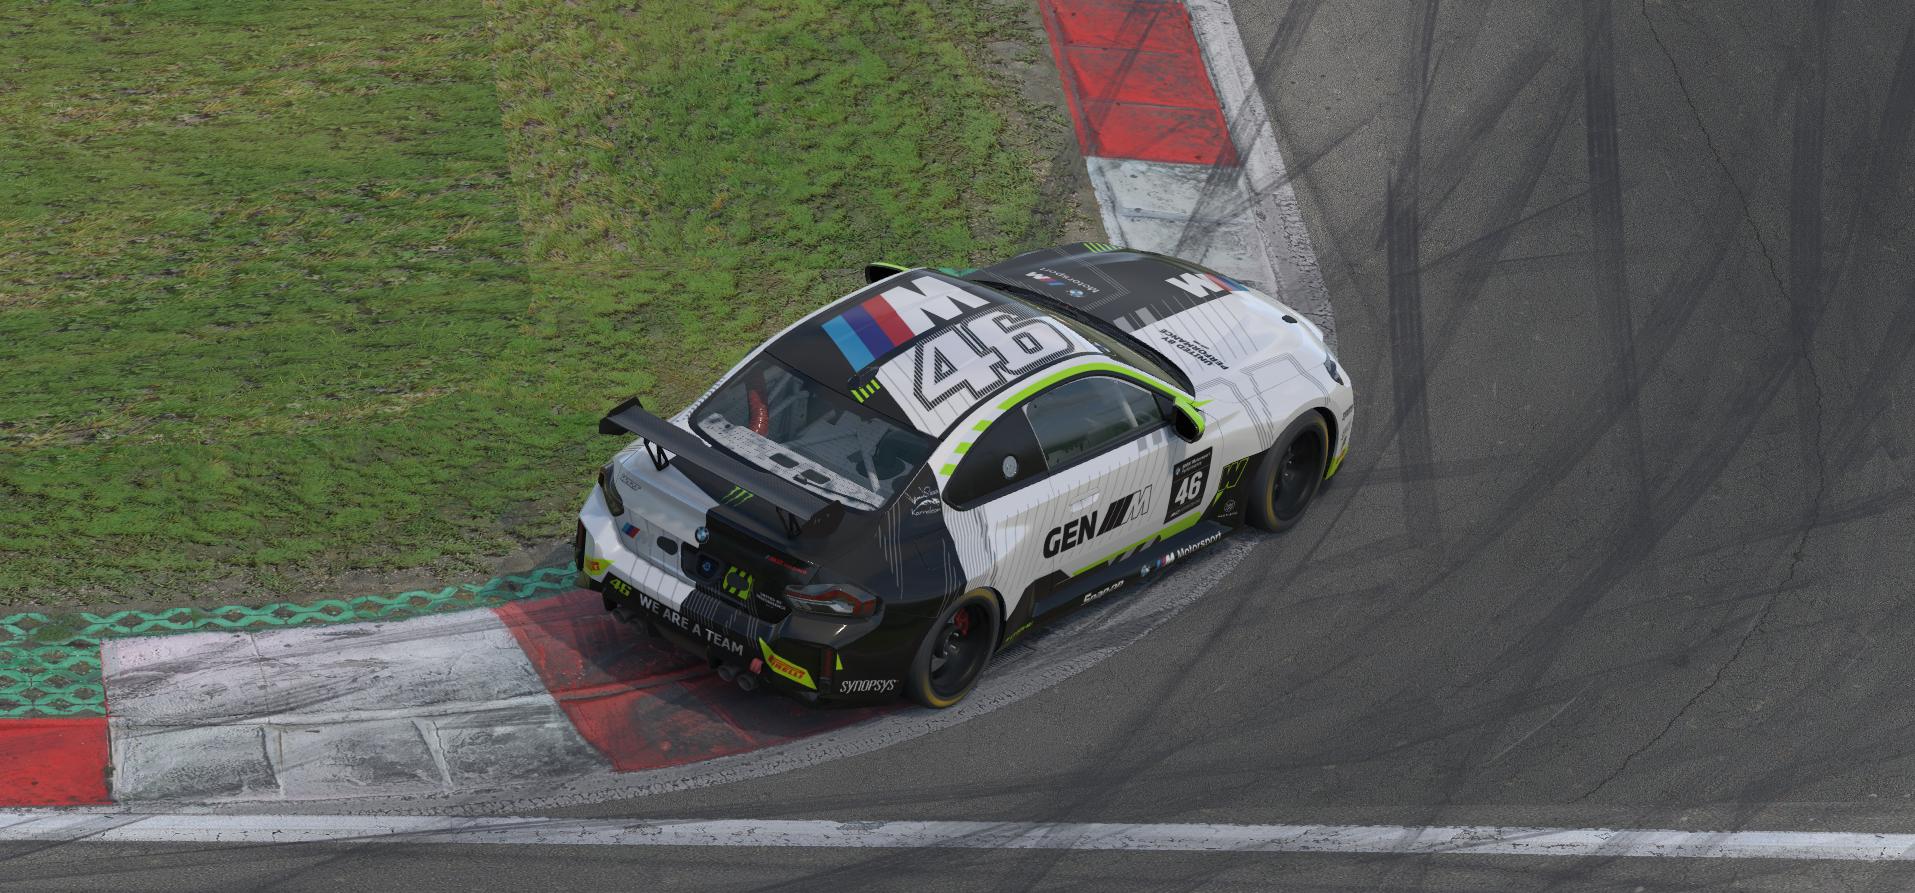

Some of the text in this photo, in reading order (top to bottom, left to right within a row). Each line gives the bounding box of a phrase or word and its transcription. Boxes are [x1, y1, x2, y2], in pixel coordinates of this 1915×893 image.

[1040, 267, 1100, 293] Motorsport
[880, 275, 991, 336] M
[1160, 328, 1229, 370] PERFORMANCE
[1161, 336, 1176, 345] BY
[1176, 344, 1213, 366] UNITED
[913, 303, 1076, 412] 46
[1174, 471, 1203, 505] 46
[1043, 510, 1098, 559] GEN
[1176, 530, 1222, 559] Motorsport
[610, 578, 632, 597] 46
[640, 593, 744, 657] WE ARE A TEAM
[839, 678, 897, 695] SYNOPSYS
